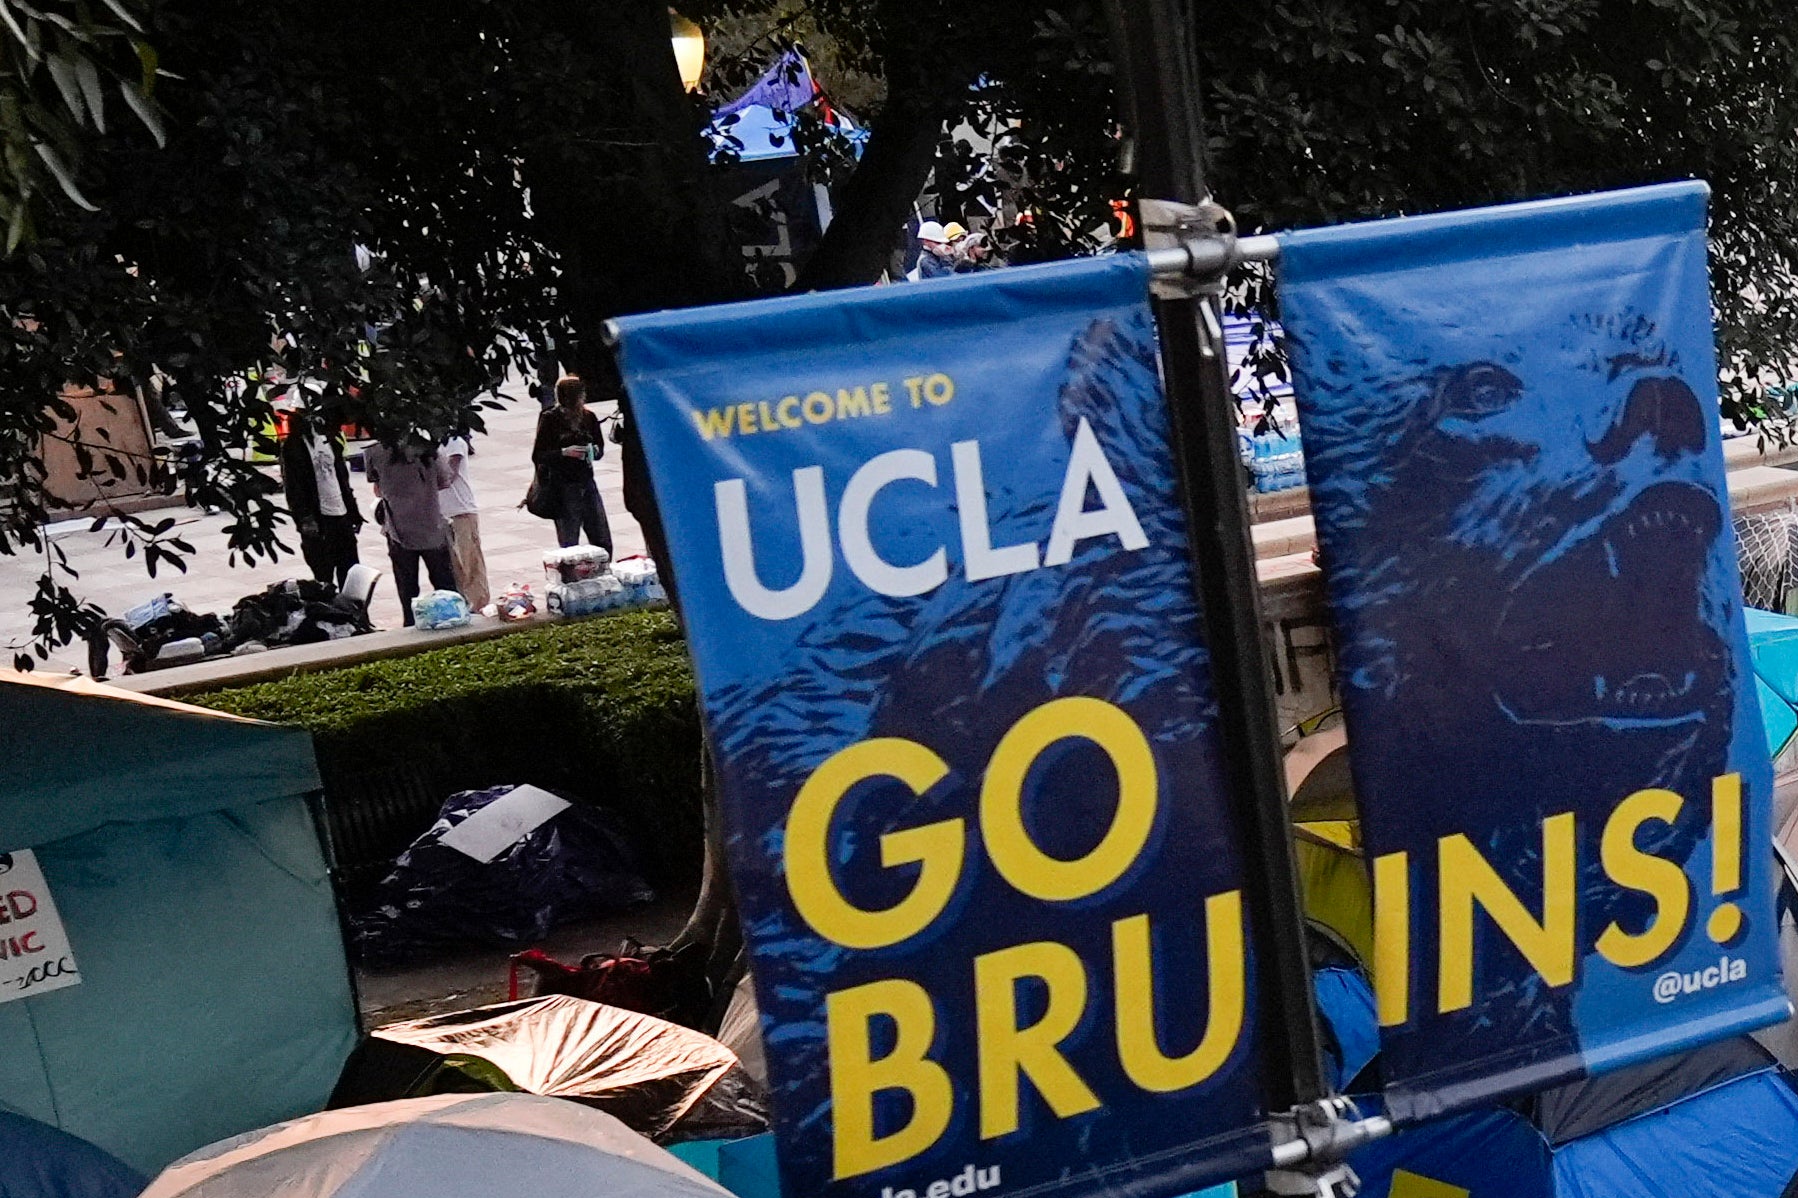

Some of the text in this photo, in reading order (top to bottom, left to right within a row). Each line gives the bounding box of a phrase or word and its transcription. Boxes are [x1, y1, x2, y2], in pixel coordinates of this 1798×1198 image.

[693, 373, 955, 441] WELCOME TO
[715, 416, 1150, 620] UCLA
[786, 697, 1158, 948] GO
[1373, 772, 1742, 1026] INS!
[829, 890, 1245, 1179] BRU
[1654, 957, 1748, 1004] @ucla
